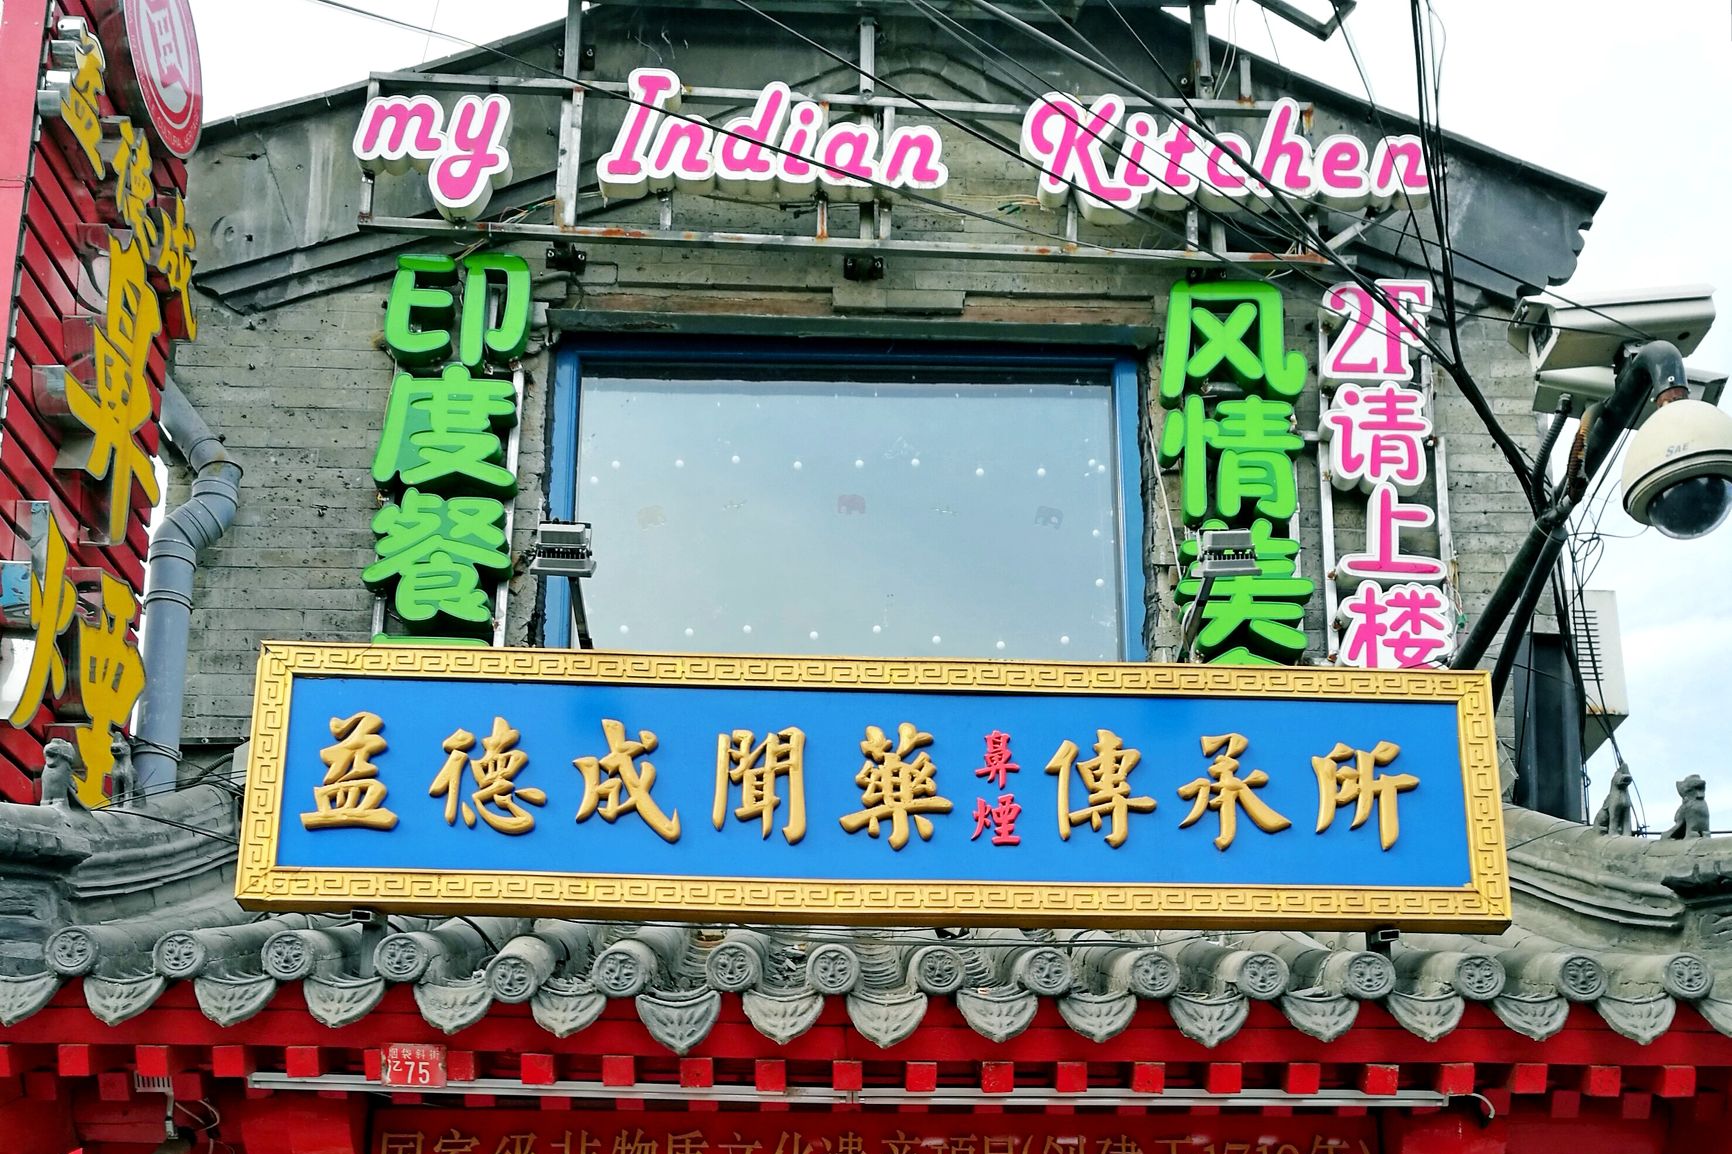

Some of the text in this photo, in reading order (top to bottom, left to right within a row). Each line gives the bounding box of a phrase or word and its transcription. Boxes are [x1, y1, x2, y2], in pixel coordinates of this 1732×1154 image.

[358, 70, 1432, 206] my Indian Kitchen
[380, 252, 530, 647] 印度餐
[1160, 281, 1312, 666] 风情美
